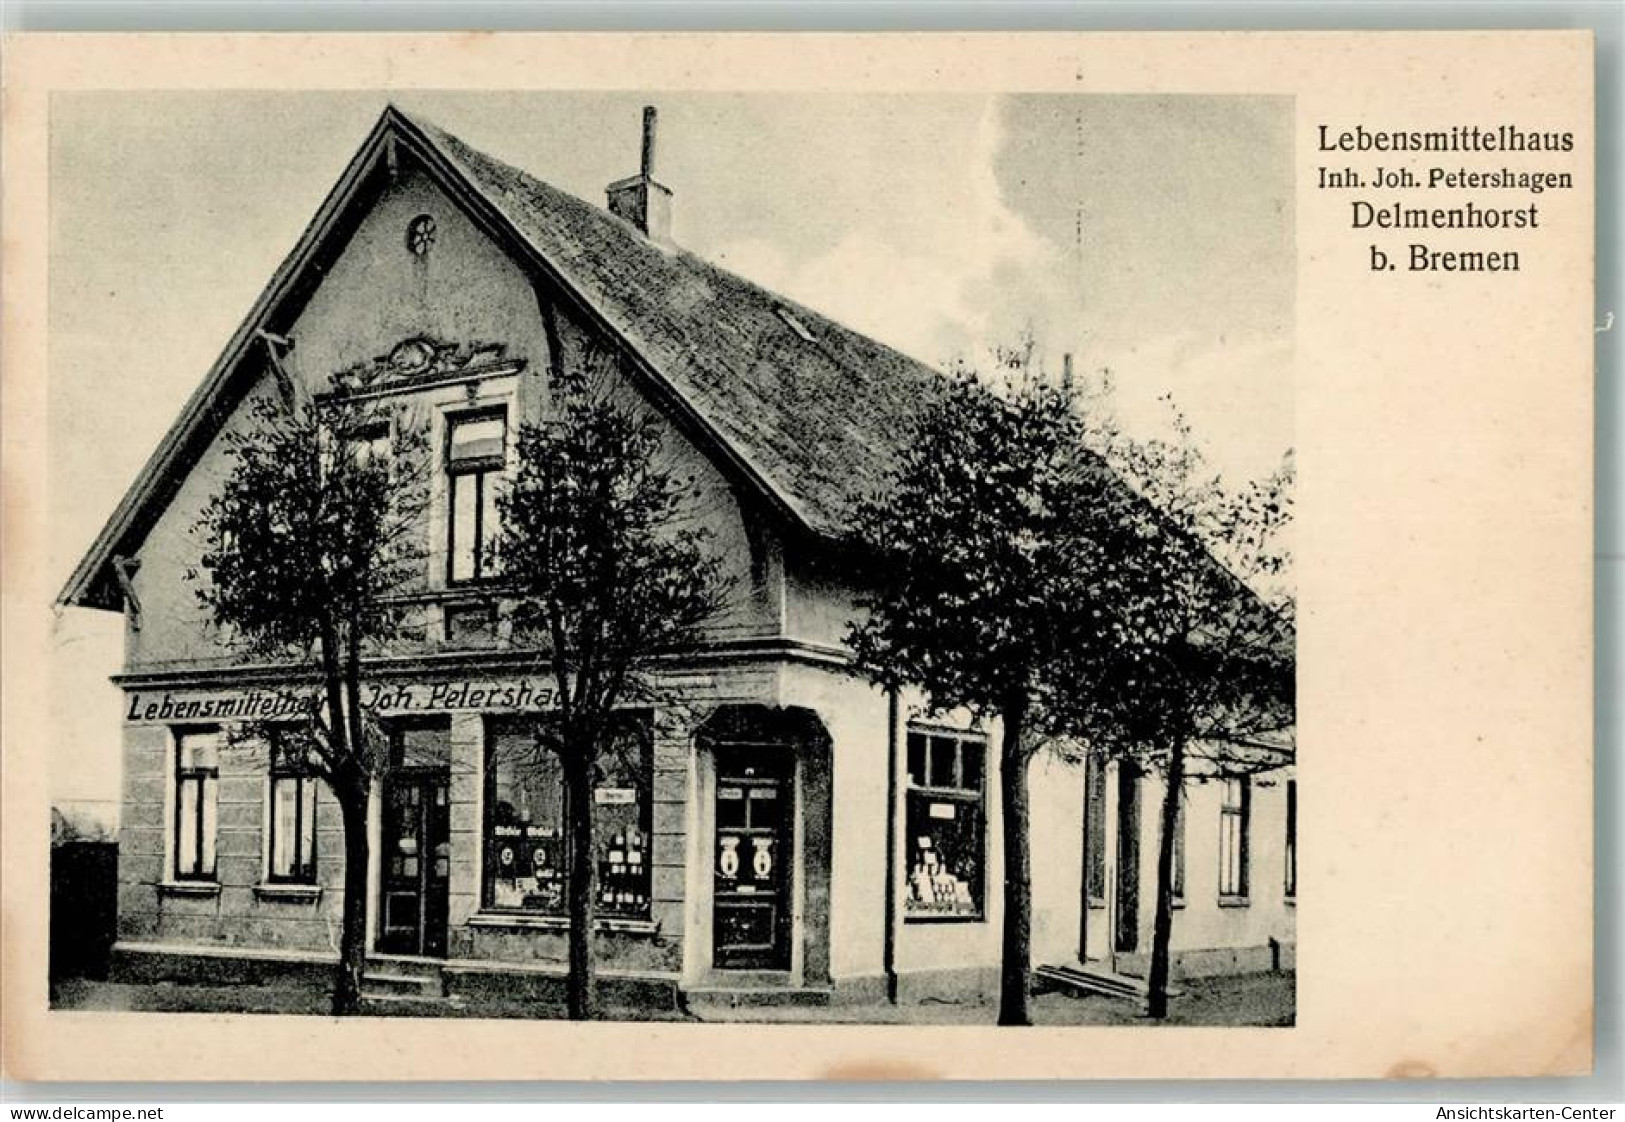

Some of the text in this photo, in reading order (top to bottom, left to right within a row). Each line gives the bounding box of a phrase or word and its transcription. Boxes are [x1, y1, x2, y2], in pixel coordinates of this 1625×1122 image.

[1318, 125, 1574, 151] Lebensmittelhaus
[1318, 167, 1573, 193] Inh. Joh. Petershagen
[1352, 201, 1539, 228] Delmenhorst
[1370, 245, 1520, 271] b. Bremen
[360, 685, 421, 710] Joh.
